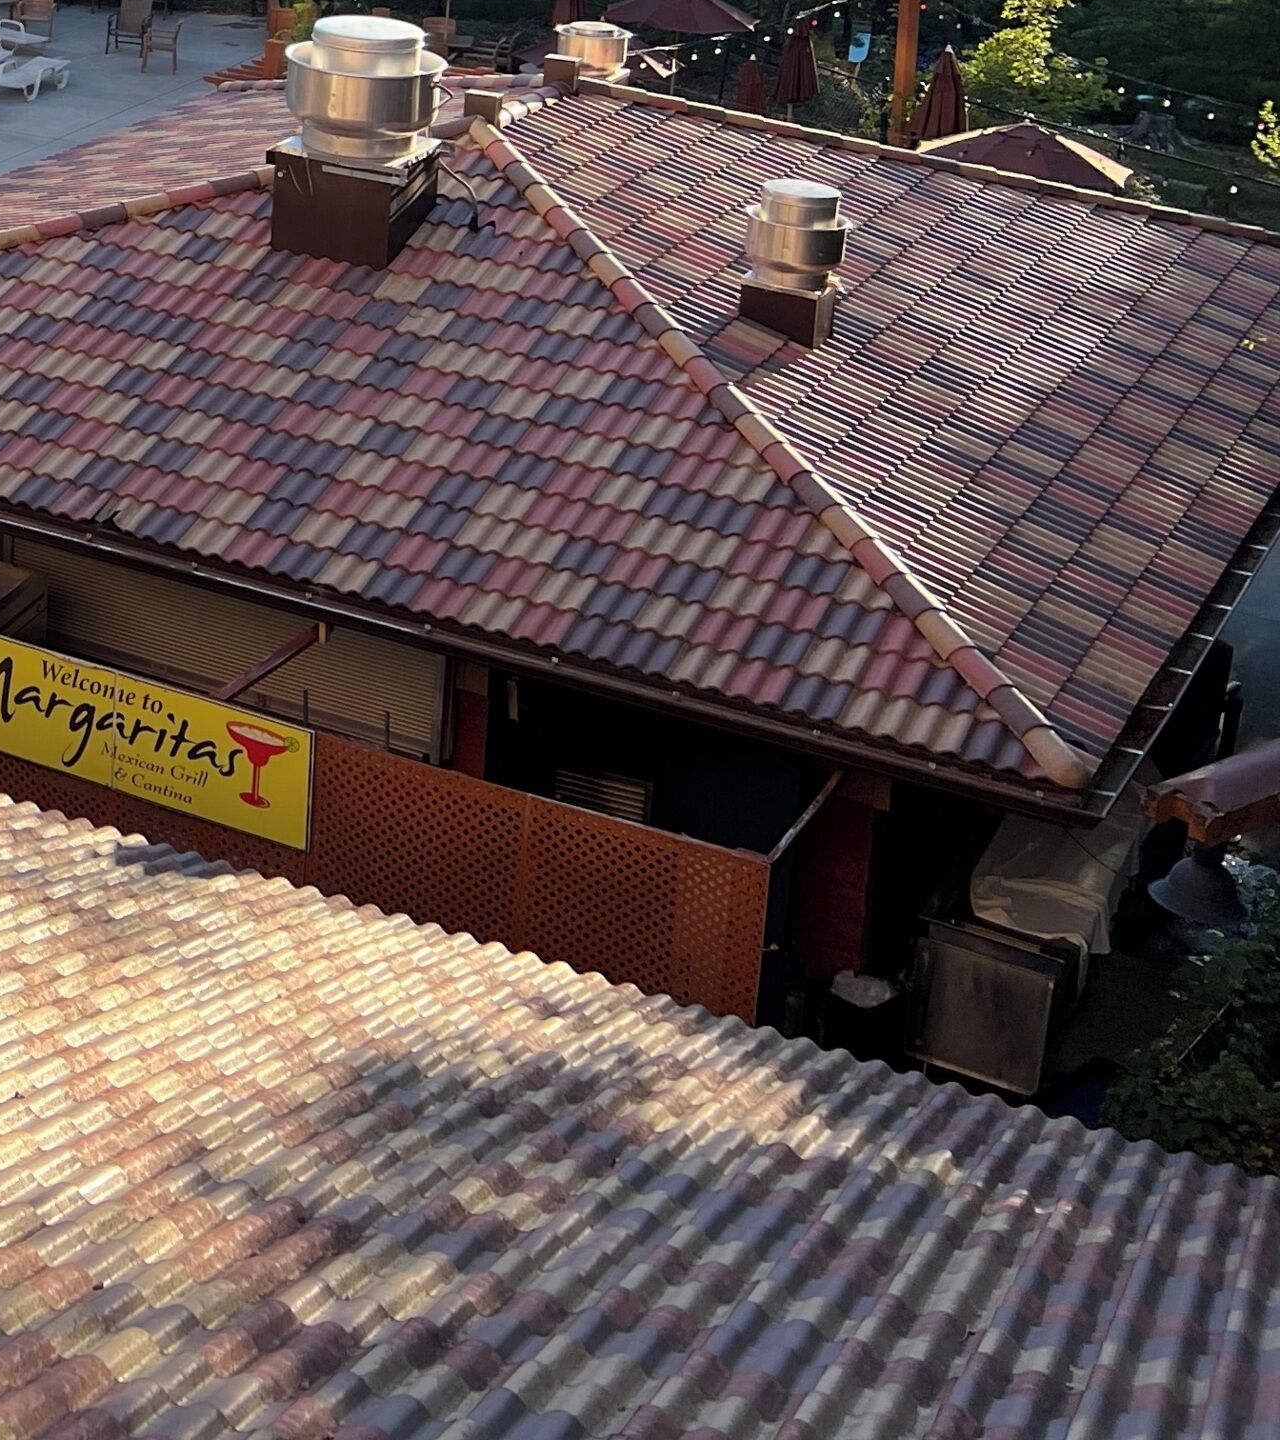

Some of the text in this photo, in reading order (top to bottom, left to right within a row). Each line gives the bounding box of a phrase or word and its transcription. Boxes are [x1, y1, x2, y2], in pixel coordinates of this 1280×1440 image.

[41, 659, 163, 714] Welcome to
[100, 741, 209, 788] Mexican Grill
[113, 766, 193, 805] & Cantina
